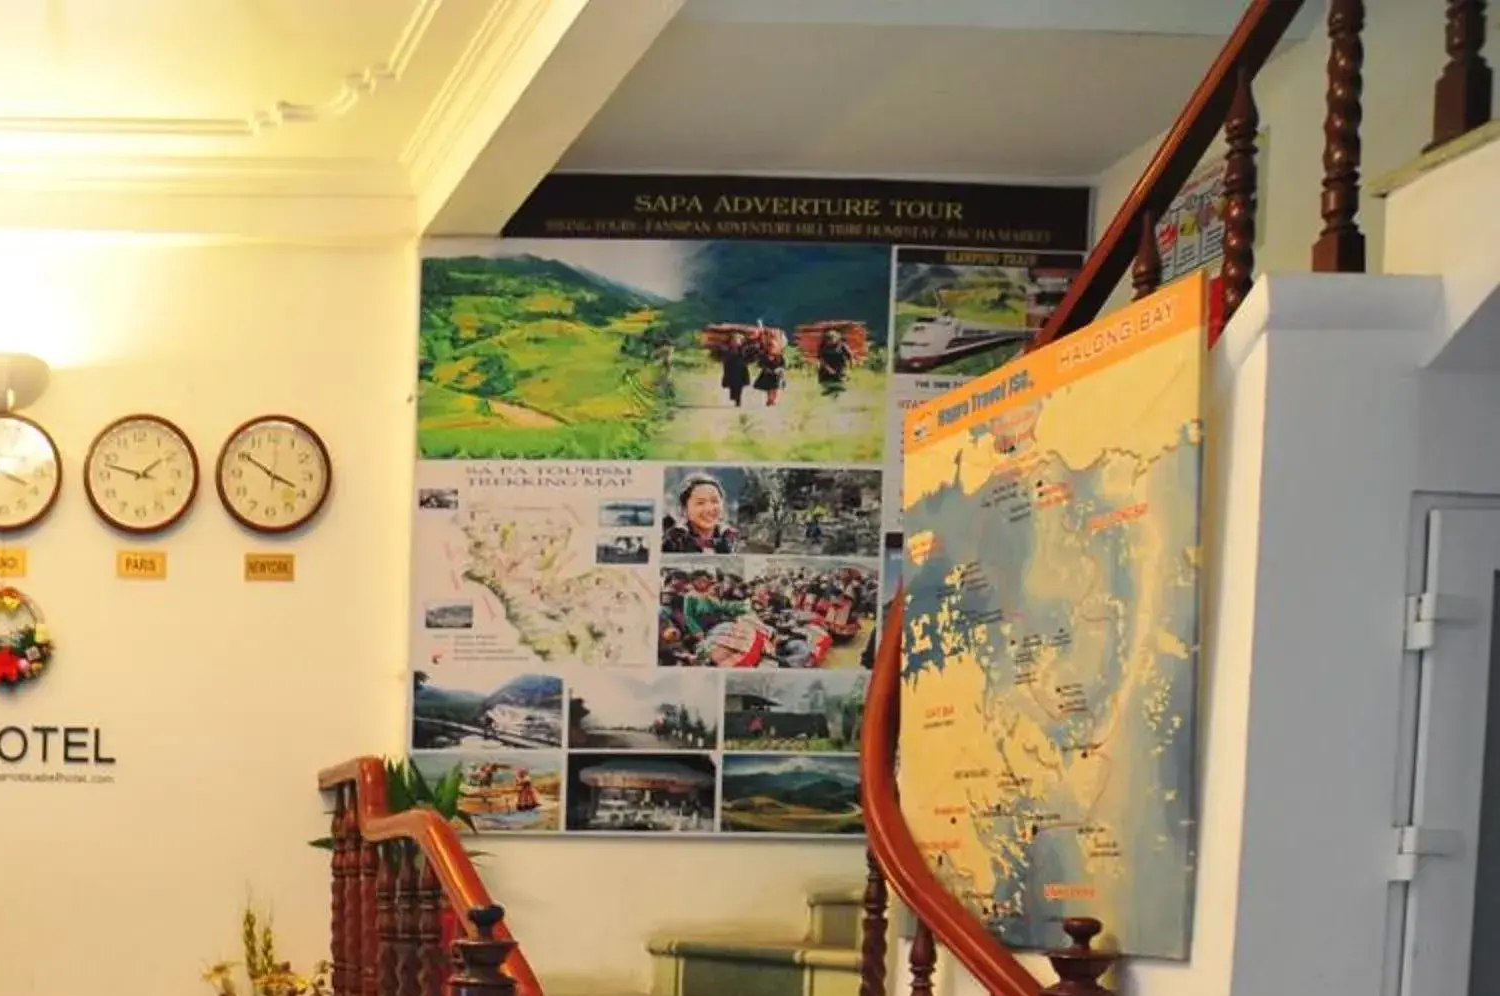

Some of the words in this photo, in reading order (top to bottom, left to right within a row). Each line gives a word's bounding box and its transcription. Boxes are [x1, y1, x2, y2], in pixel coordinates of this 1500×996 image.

[634, 194, 703, 213] SAPA
[714, 195, 881, 217] ADVERTURE
[890, 200, 963, 220] TOUR
[125, 556, 156, 572] PARIS
